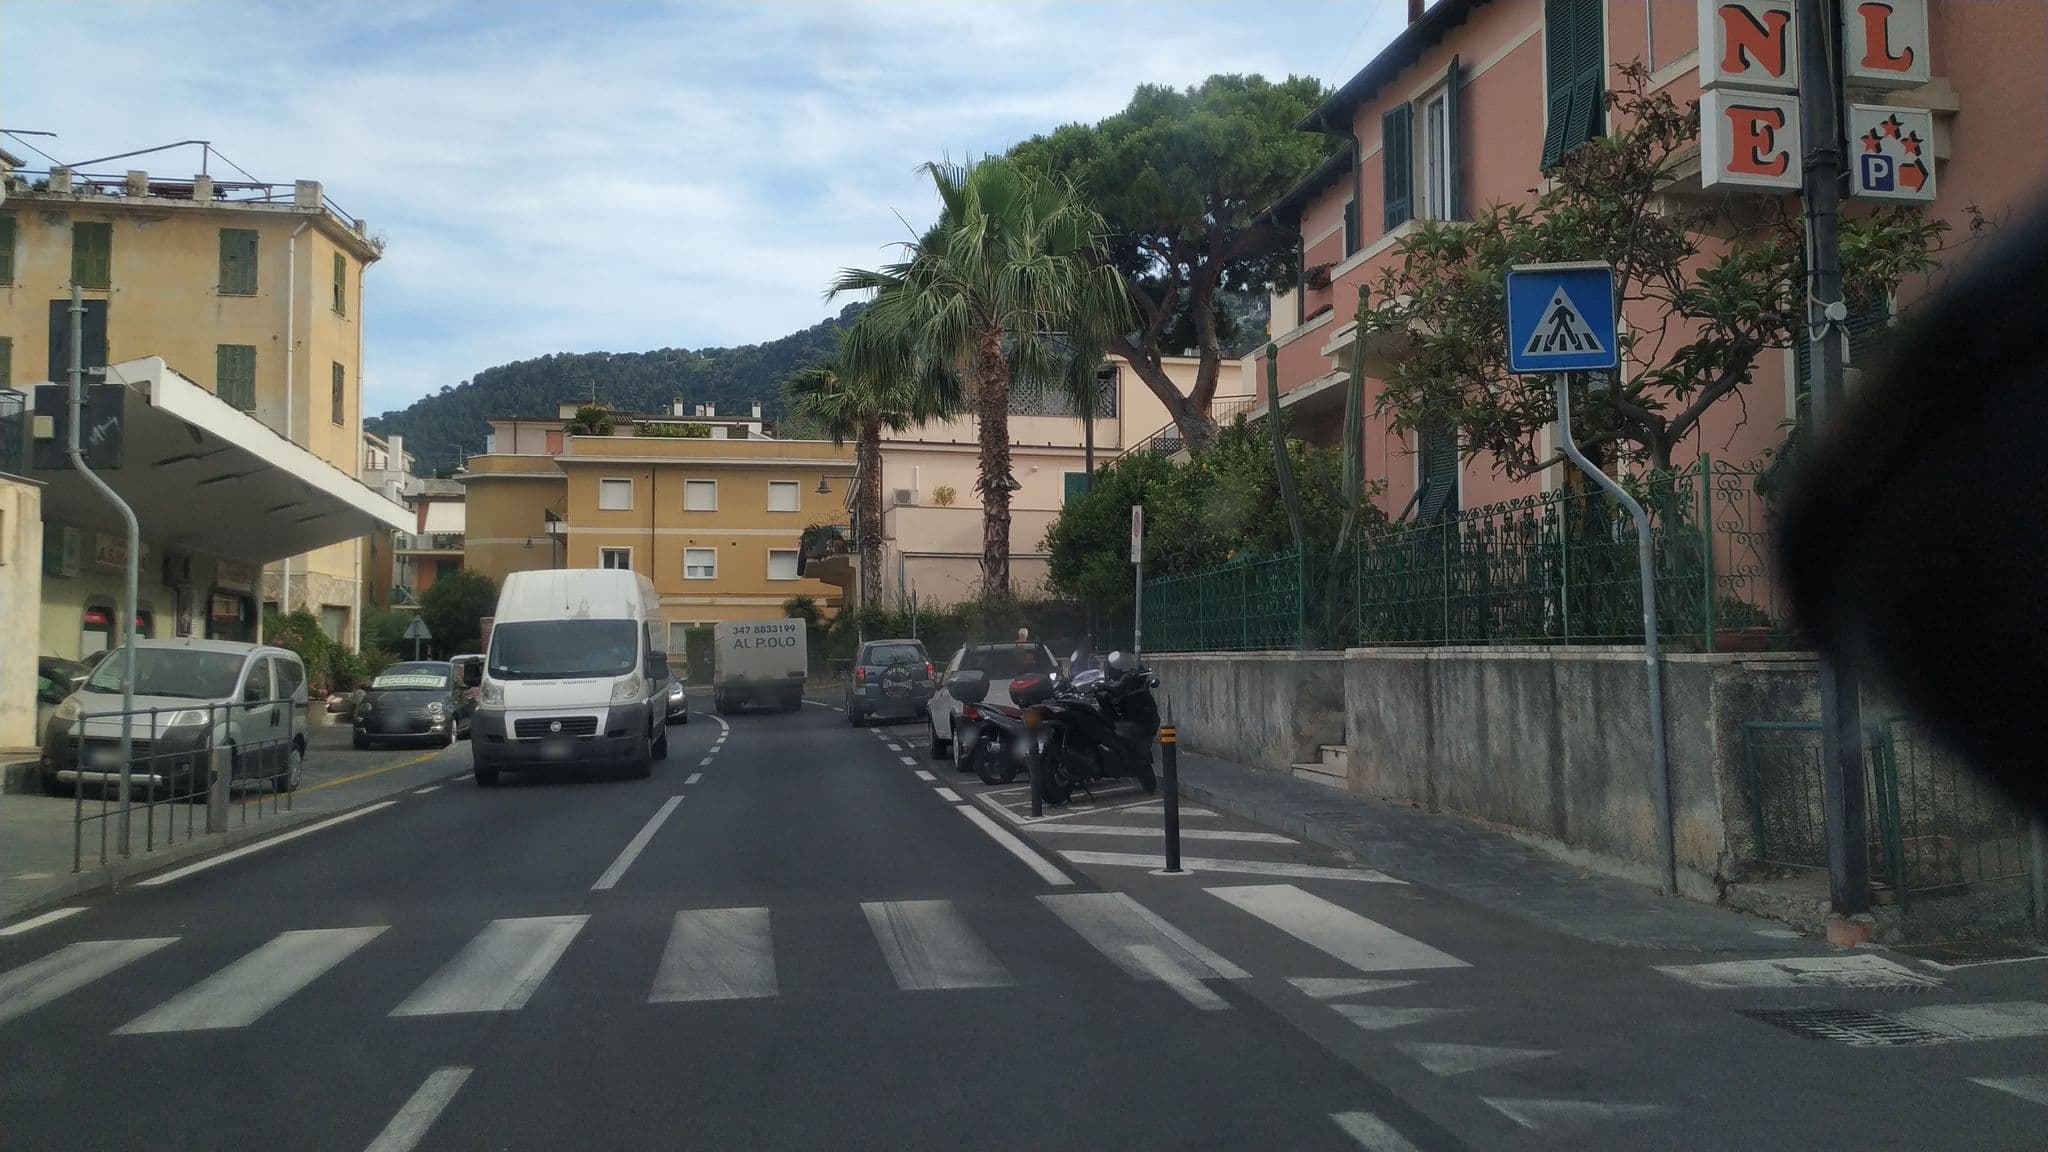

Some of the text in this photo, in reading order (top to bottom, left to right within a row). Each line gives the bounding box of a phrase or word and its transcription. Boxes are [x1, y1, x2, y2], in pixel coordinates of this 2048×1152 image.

[1868, 157, 1888, 187] P
[732, 626, 751, 635] 347
[734, 638, 752, 649] AL
